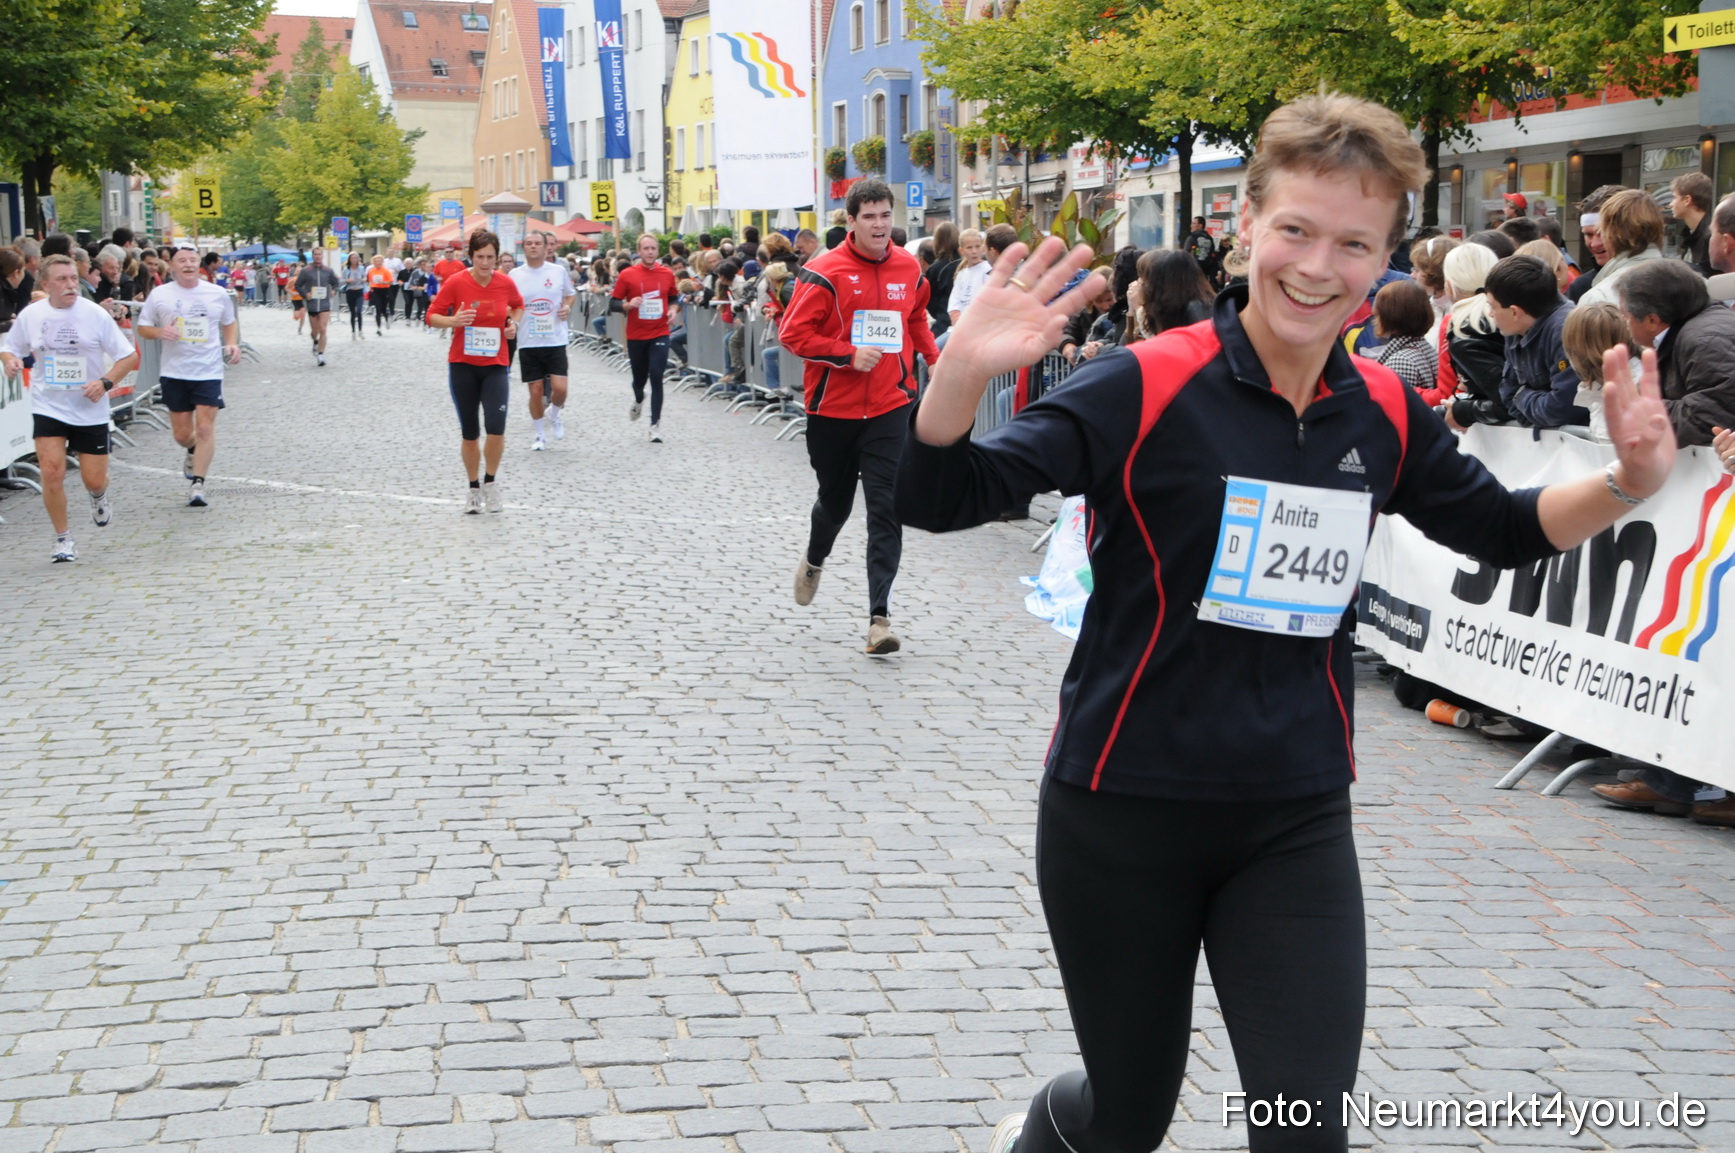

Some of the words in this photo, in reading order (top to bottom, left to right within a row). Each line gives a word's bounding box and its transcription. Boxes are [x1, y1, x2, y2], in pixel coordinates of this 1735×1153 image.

[1687, 20, 1735, 39] Toilett
[612, 53, 623, 111] RUPPERT
[616, 113, 625, 137] K&L
[194, 177, 217, 186] Block
[592, 183, 613, 193] Block
[200, 189, 213, 209] B
[597, 194, 610, 213] B
[887, 292, 906, 300] OMV
[867, 314, 890, 322] Thomas
[187, 328, 205, 338] 305
[867, 326, 897, 338] 3442
[475, 338, 497, 347] 2153
[57, 369, 82, 379] 2521
[1338, 463, 1366, 474] adidas
[1271, 499, 1319, 529] Anita
[1228, 534, 1240, 554] D
[1263, 542, 1350, 586] 2449
[1445, 614, 1570, 688] stadtwerke
[1574, 658, 1696, 727] neumarkt
